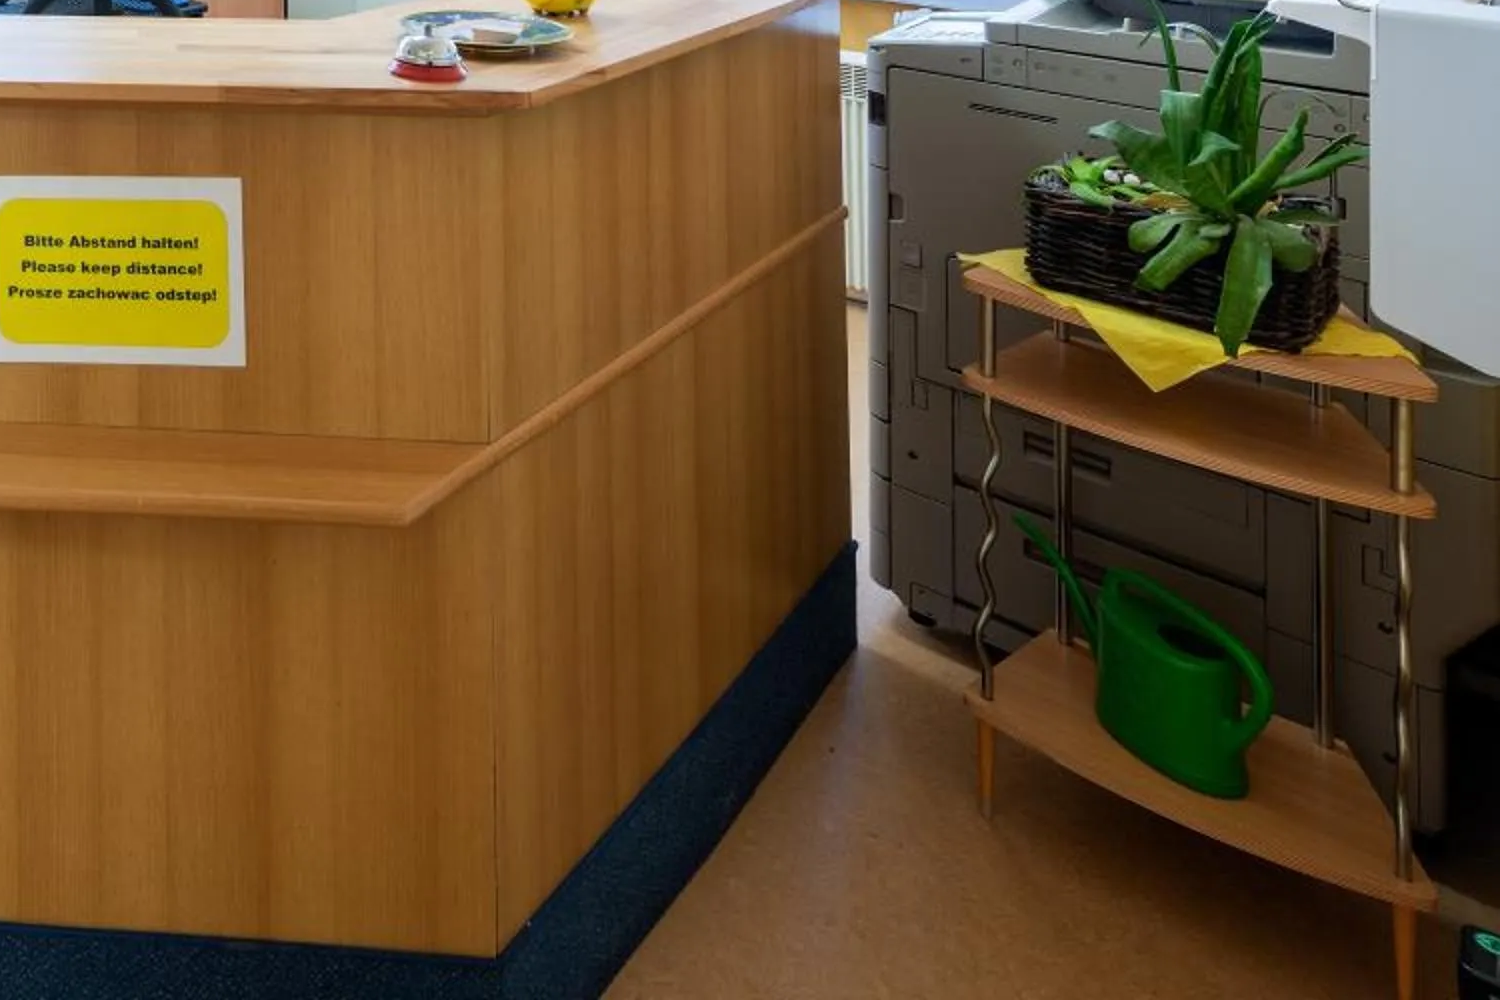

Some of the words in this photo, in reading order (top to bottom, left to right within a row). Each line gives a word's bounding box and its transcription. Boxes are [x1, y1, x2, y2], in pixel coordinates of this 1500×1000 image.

[23, 235, 64, 248] Bitte
[69, 235, 136, 249] Abstand
[141, 236, 199, 249] halten!
[21, 260, 76, 273] Please
[81, 261, 121, 276] keep
[126, 262, 203, 275] distance!
[7, 285, 63, 298] Prosze
[67, 287, 150, 300] zachowac
[156, 289, 217, 304] odstep!
